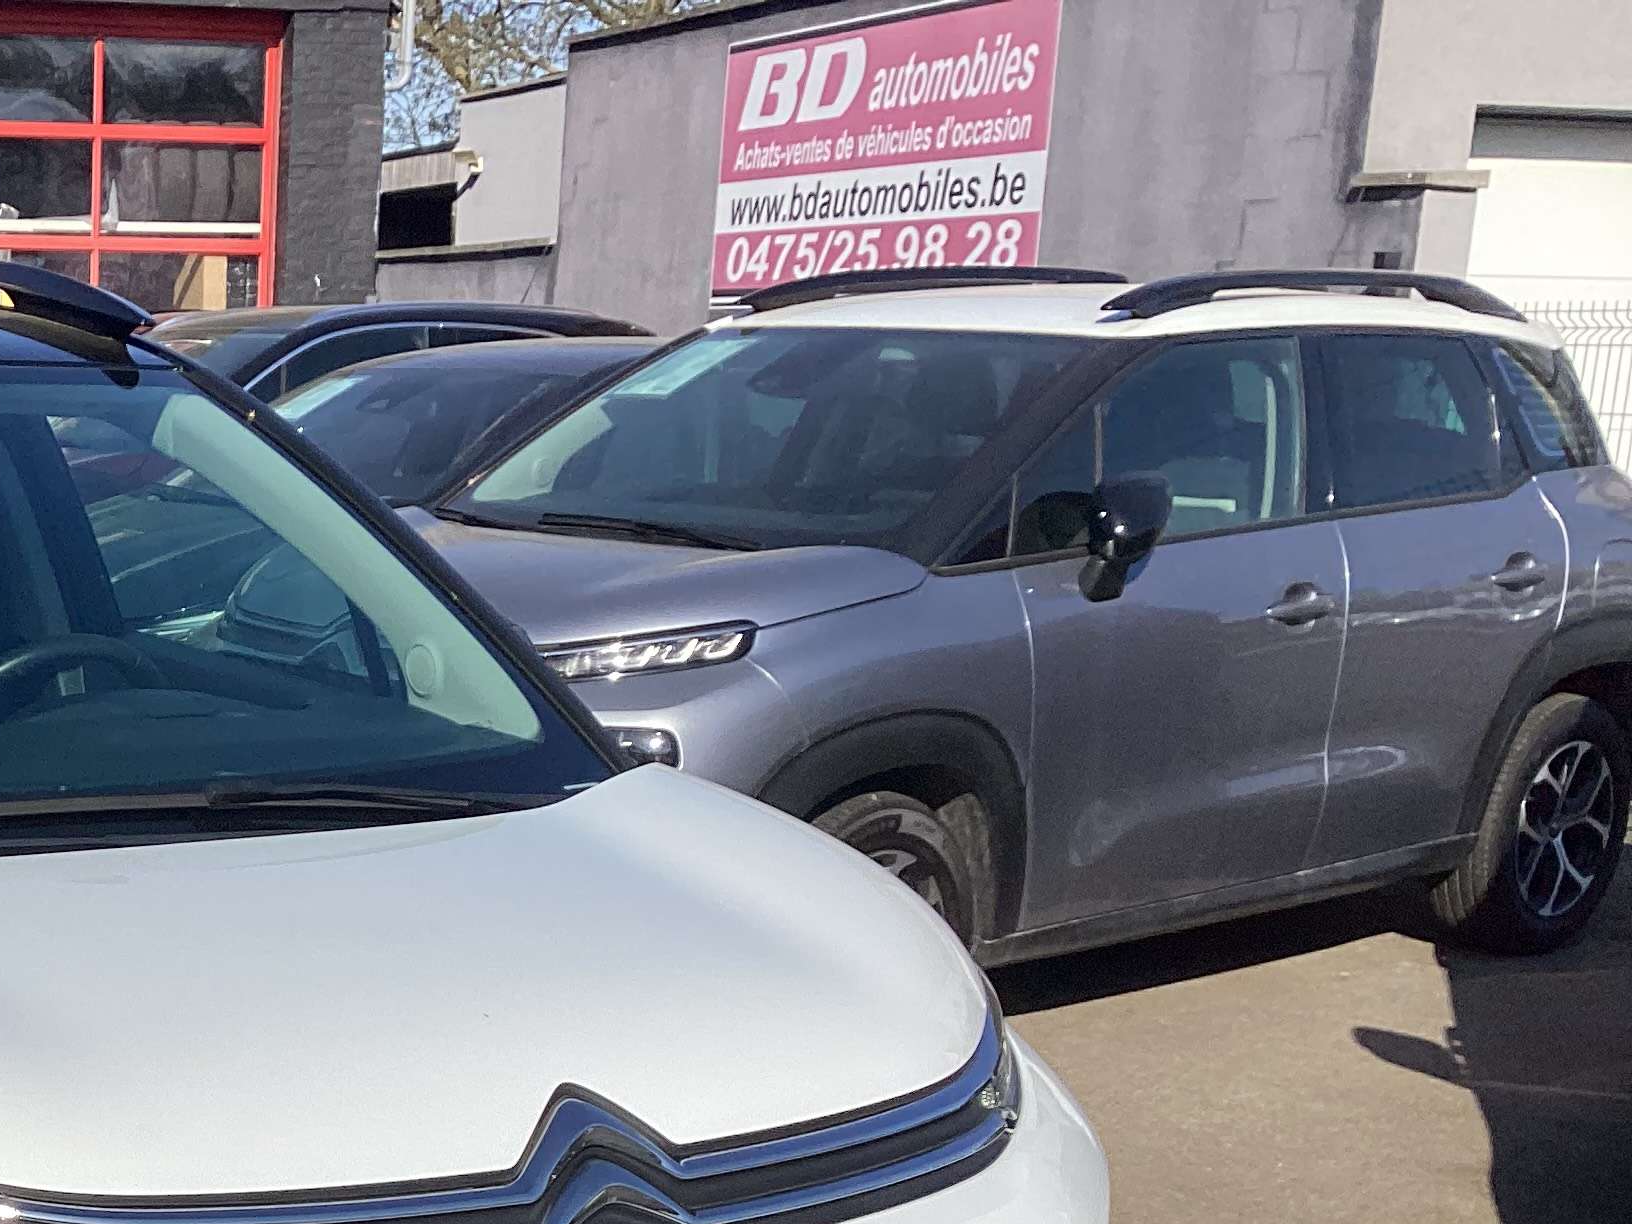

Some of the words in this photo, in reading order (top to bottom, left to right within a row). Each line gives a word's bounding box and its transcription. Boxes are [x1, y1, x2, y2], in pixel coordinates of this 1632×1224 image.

[737, 37, 868, 131] BD
[868, 32, 1040, 112] automobiles
[734, 127, 832, 173] Achats-ventes
[834, 129, 854, 161] de
[857, 119, 932, 159] véhicules
[935, 108, 1033, 150] d'occasion
[730, 162, 1026, 227] www.bdautomobiles.be
